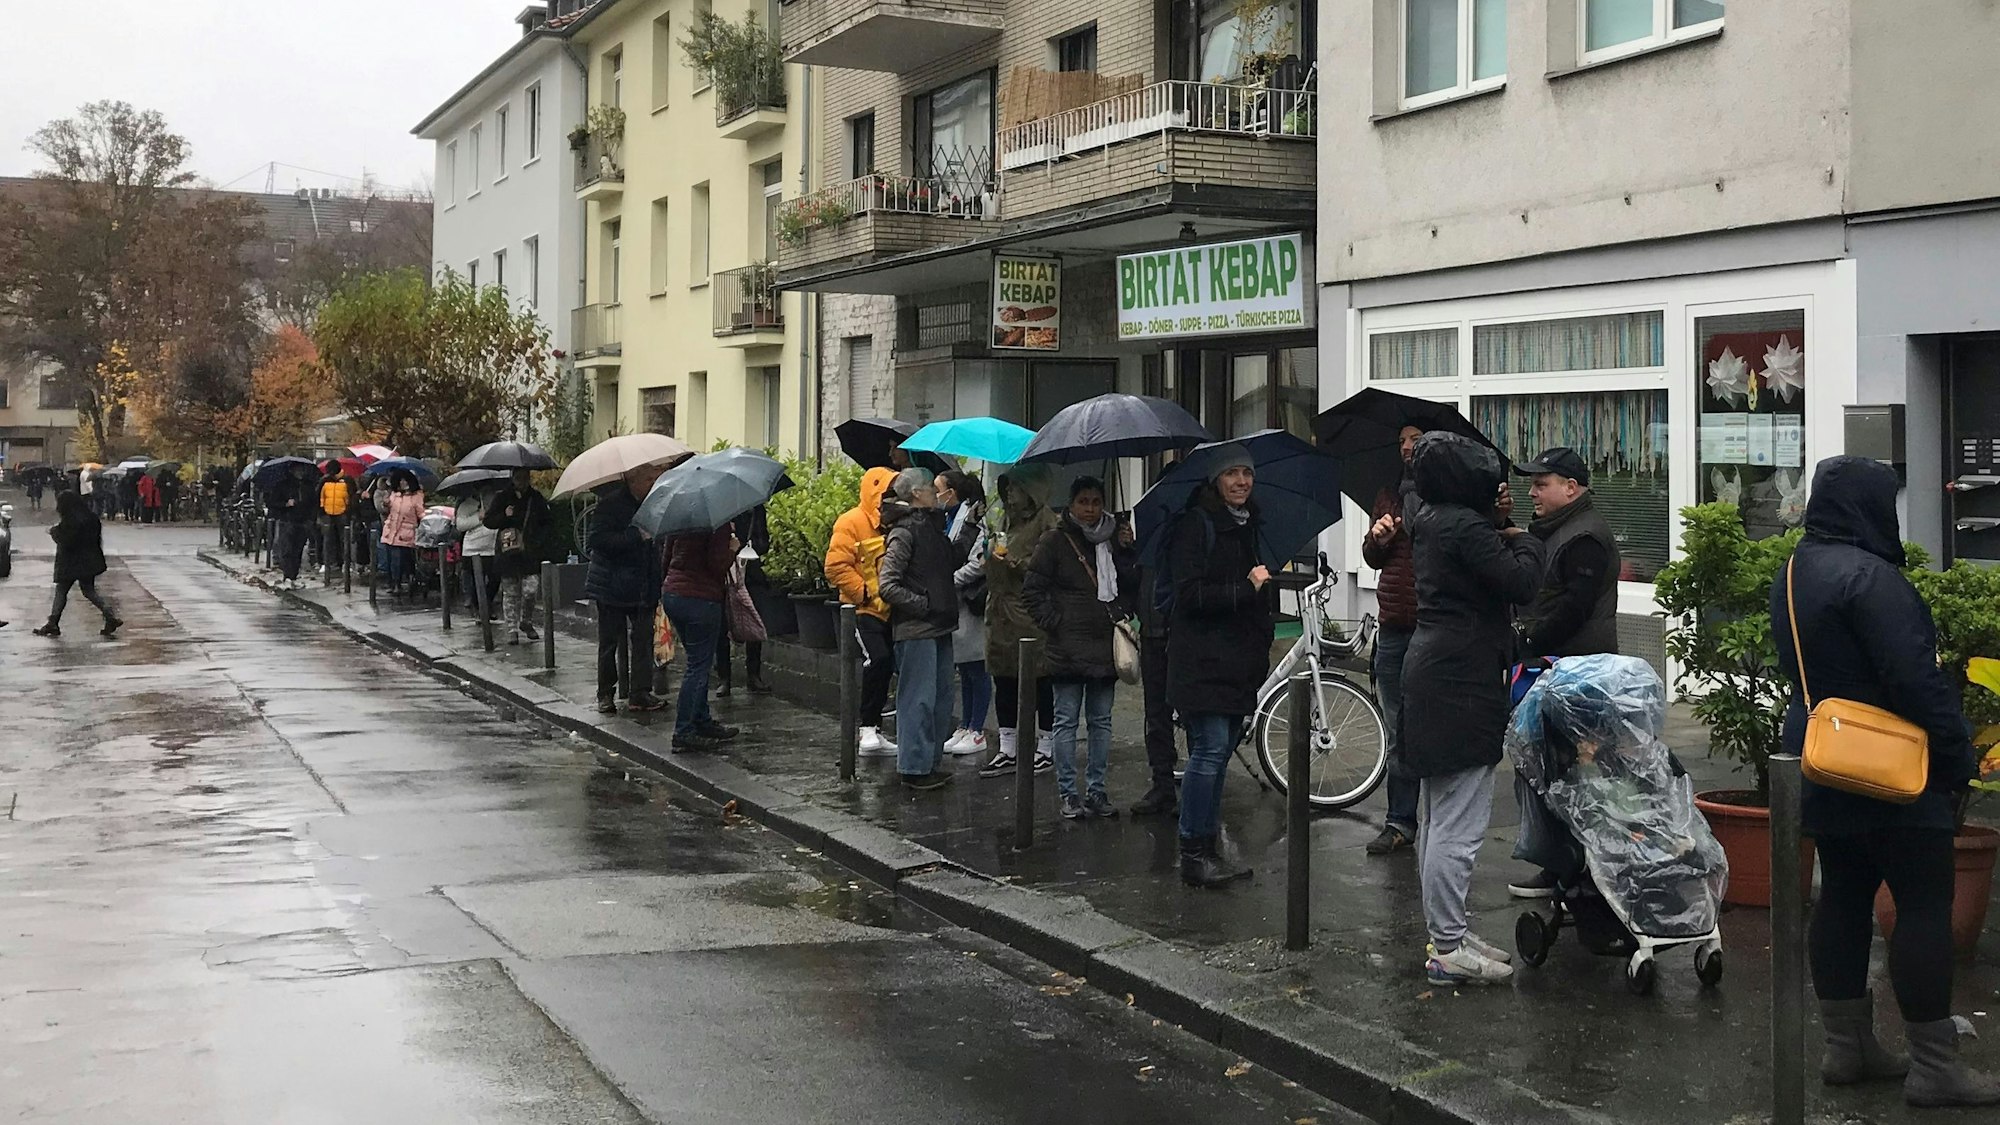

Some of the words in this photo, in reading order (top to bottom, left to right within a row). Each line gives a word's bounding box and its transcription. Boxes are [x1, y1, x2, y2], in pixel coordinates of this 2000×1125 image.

[1000, 260, 1058, 281] BIRTAT
[1121, 250, 1201, 310] BIRTAT
[1209, 239, 1297, 302] KEBAP
[1000, 283, 1056, 304] KEBAP
[1120, 321, 1143, 336] KEBAP
[1149, 317, 1174, 334] DÖNER
[1179, 317, 1201, 332] SUPPE
[1208, 314, 1229, 330] PIZZA
[1235, 310, 1277, 328] TÜRKISCHE
[1278, 309, 1302, 326] PIZZA
